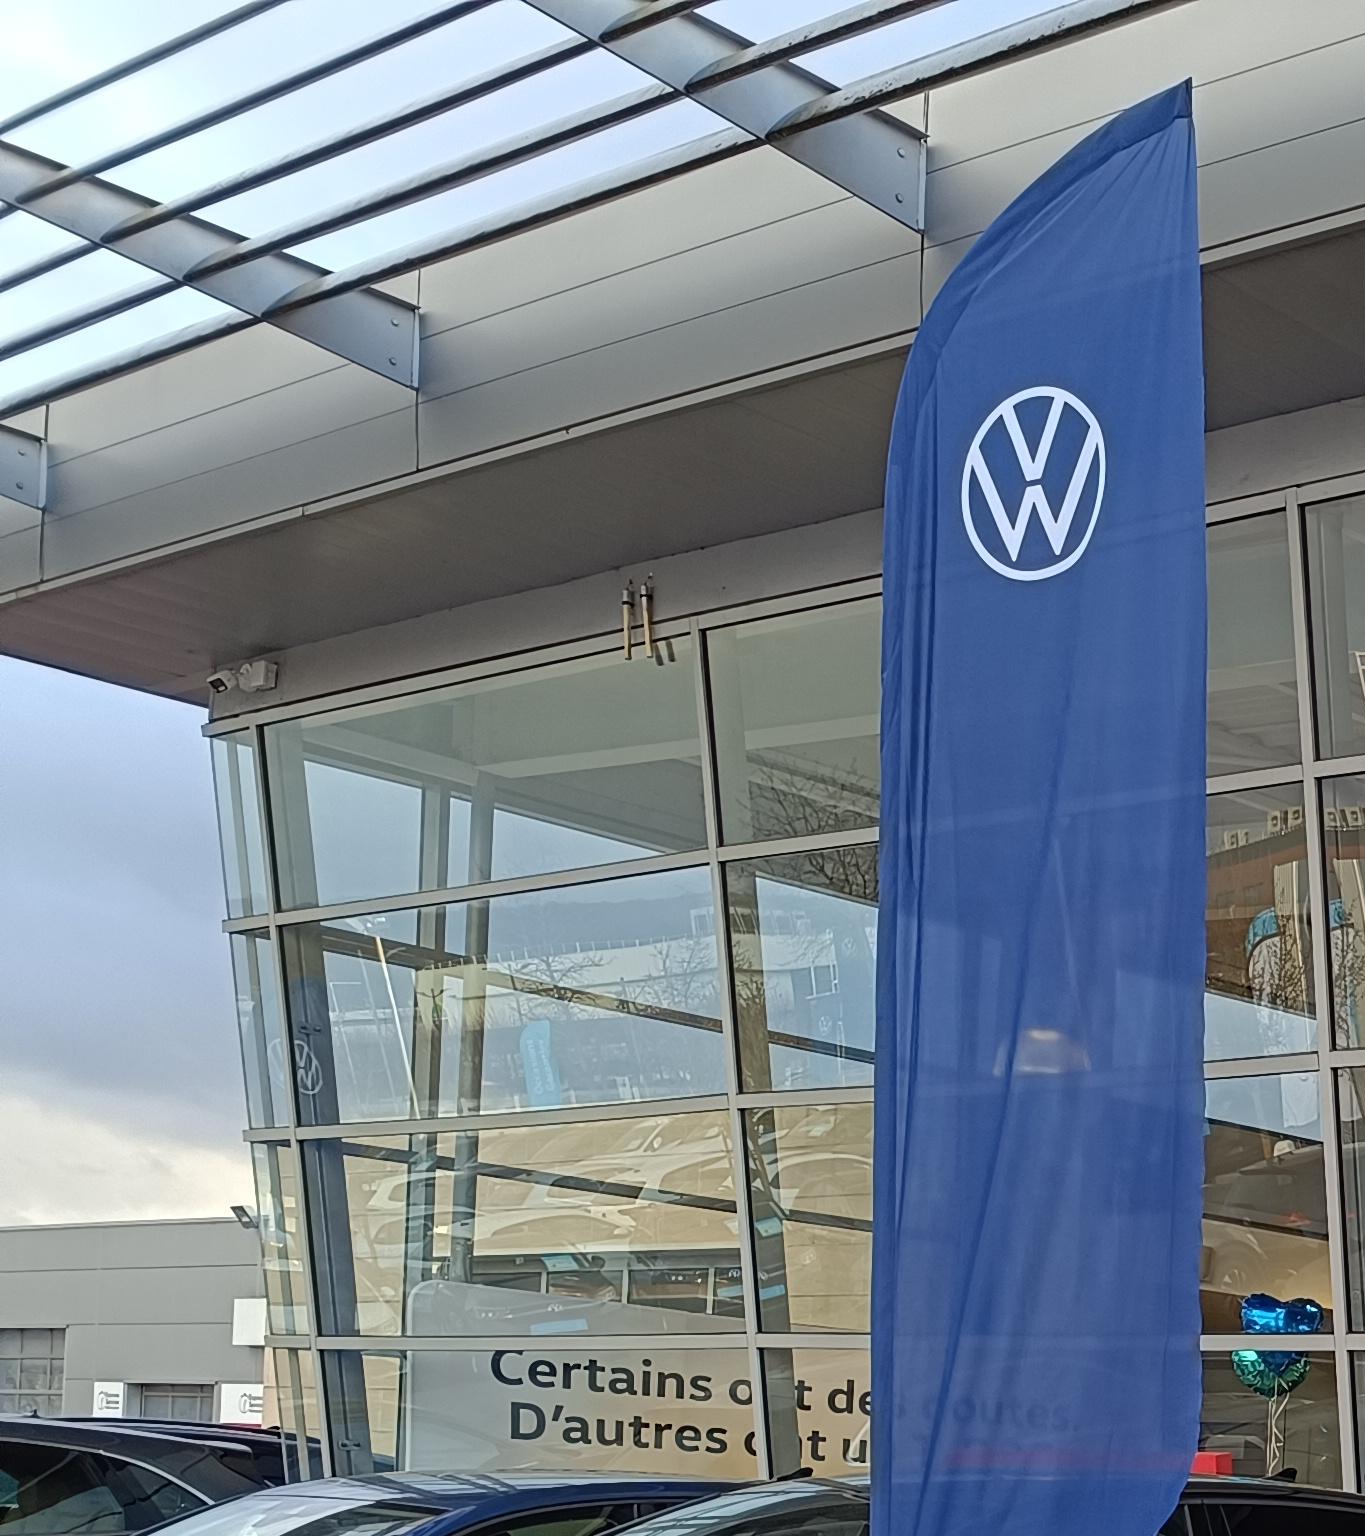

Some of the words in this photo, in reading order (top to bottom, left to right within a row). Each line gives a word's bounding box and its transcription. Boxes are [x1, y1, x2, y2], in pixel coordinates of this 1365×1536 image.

[491, 1350, 712, 1401] Certains
[729, 1379, 812, 1411] ot
[511, 1402, 728, 1453] D'autres
